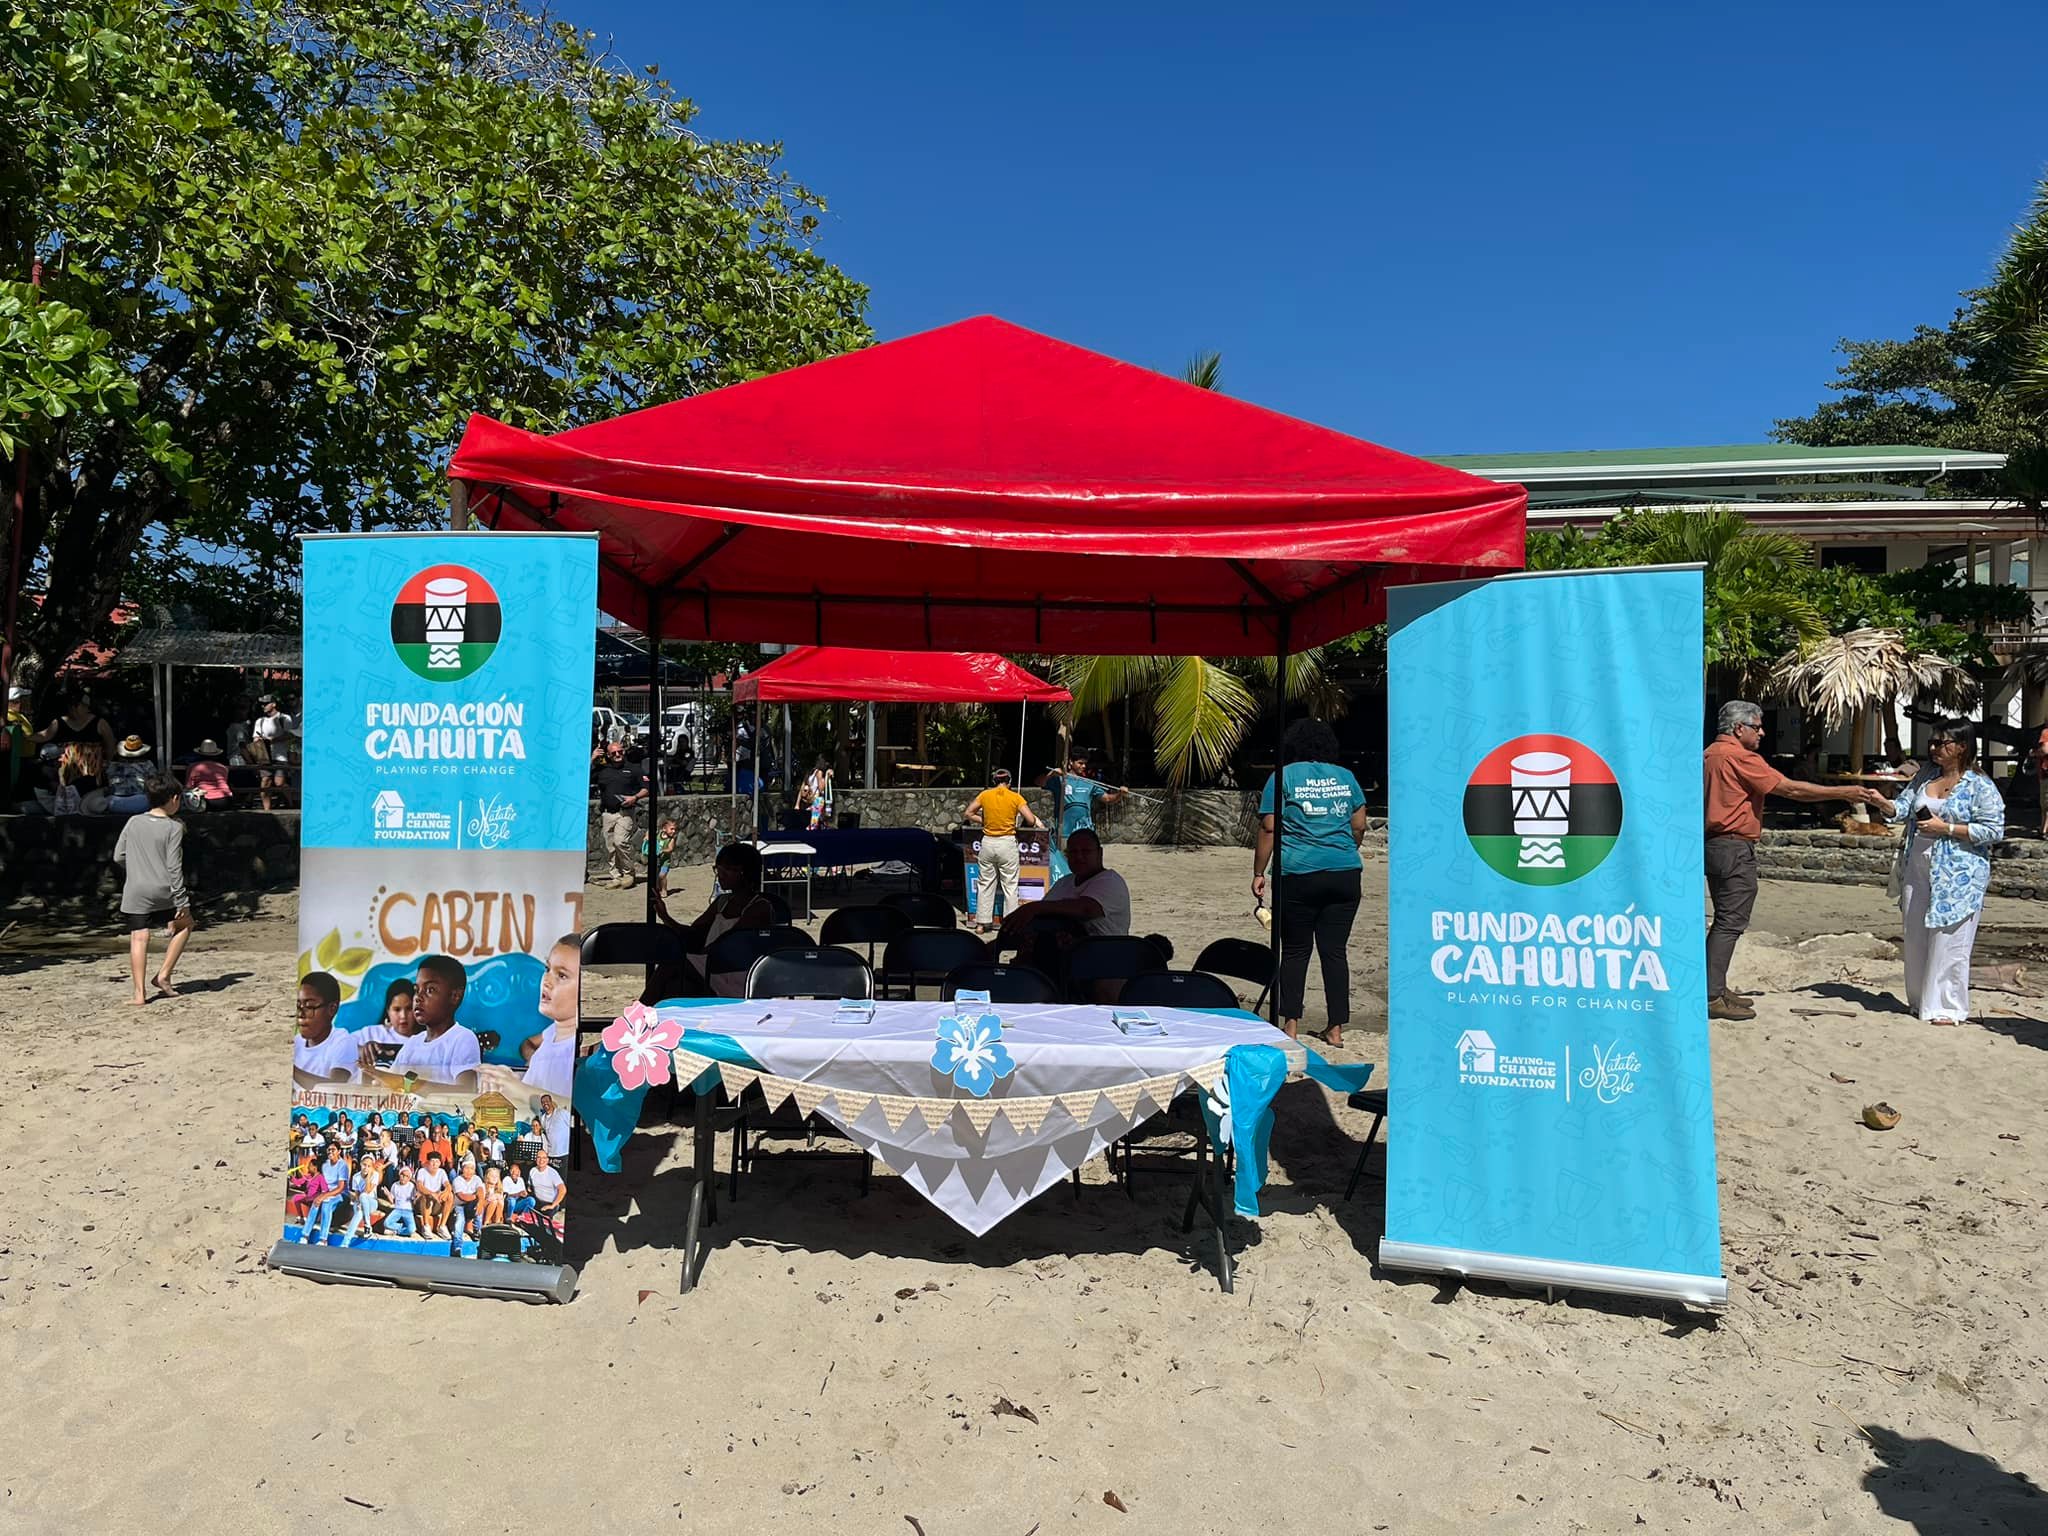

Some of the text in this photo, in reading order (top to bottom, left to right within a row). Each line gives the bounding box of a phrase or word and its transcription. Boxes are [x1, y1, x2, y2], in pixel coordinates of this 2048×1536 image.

[366, 693, 523, 727] FUNDACIÓN
[364, 728, 526, 760] CAHUITA
[376, 765, 516, 775] PLAYING FOR CHANGE
[1295, 785, 1349, 793] EMPOWERMENT
[1306, 777, 1337, 787] MUSIC
[1322, 790, 1352, 799] CHANGE
[406, 820, 450, 829] CHANGE
[374, 830, 450, 840] FOUNDATION
[378, 889, 535, 956] CABIN
[1431, 901, 1661, 947] FUNDACIÓN
[1431, 945, 1670, 991] CAHUITA
[1447, 992, 1655, 1012] PLAYING FOR CHANGE
[1499, 1055, 1543, 1065] PLAYING
[1579, 1039, 1642, 1088] Natalie
[1499, 1064, 1556, 1077] CHANGE
[1459, 1074, 1556, 1089] FOUNDATION
[352, 1094, 373, 1110] THE
